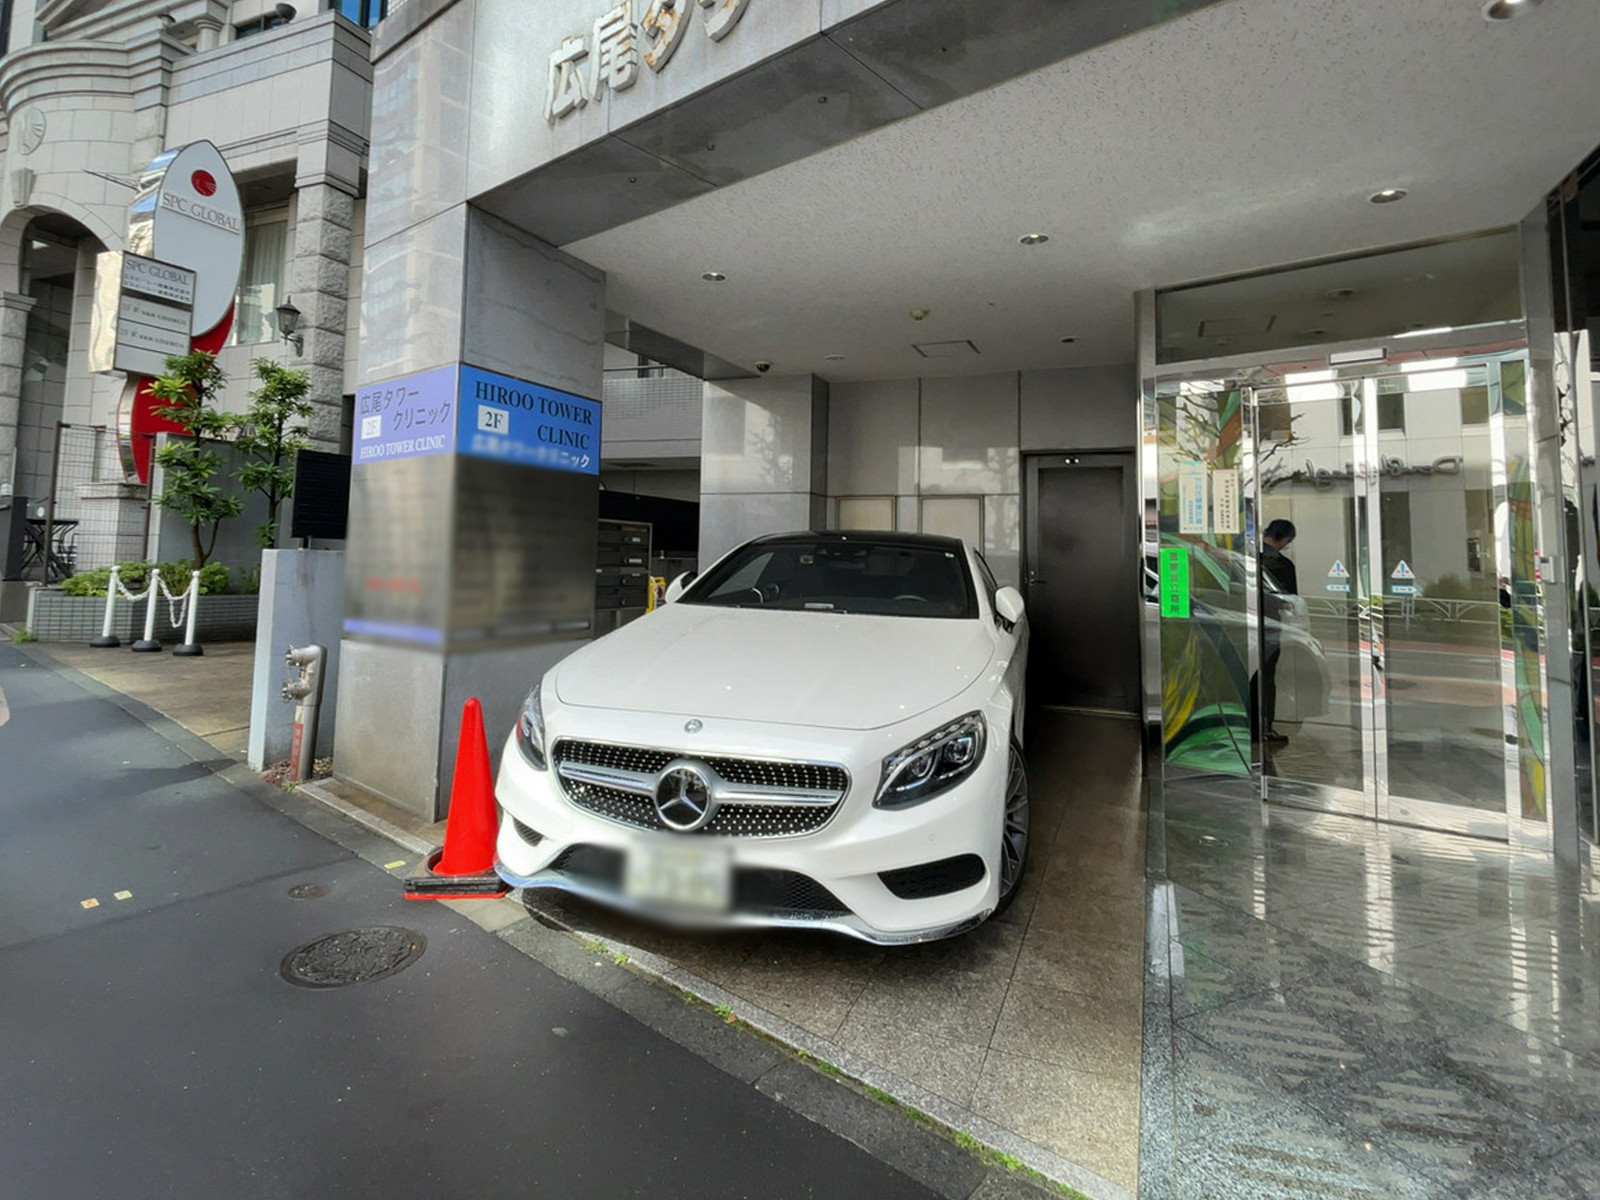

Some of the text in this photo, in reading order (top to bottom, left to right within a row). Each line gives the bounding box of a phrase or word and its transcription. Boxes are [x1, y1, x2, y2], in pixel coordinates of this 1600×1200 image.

[163, 192, 240, 231] SPC GLOBAL
[126, 259, 147, 274] SPC
[149, 266, 189, 286] GLOBAL
[361, 387, 419, 414] 広尾タワー
[475, 380, 592, 425] HIROO TOWER
[393, 401, 451, 431] クリニック
[485, 411, 504, 429] 2F
[360, 434, 446, 459] HIROO TOWER CLINIC
[537, 424, 591, 451] CLINIC
